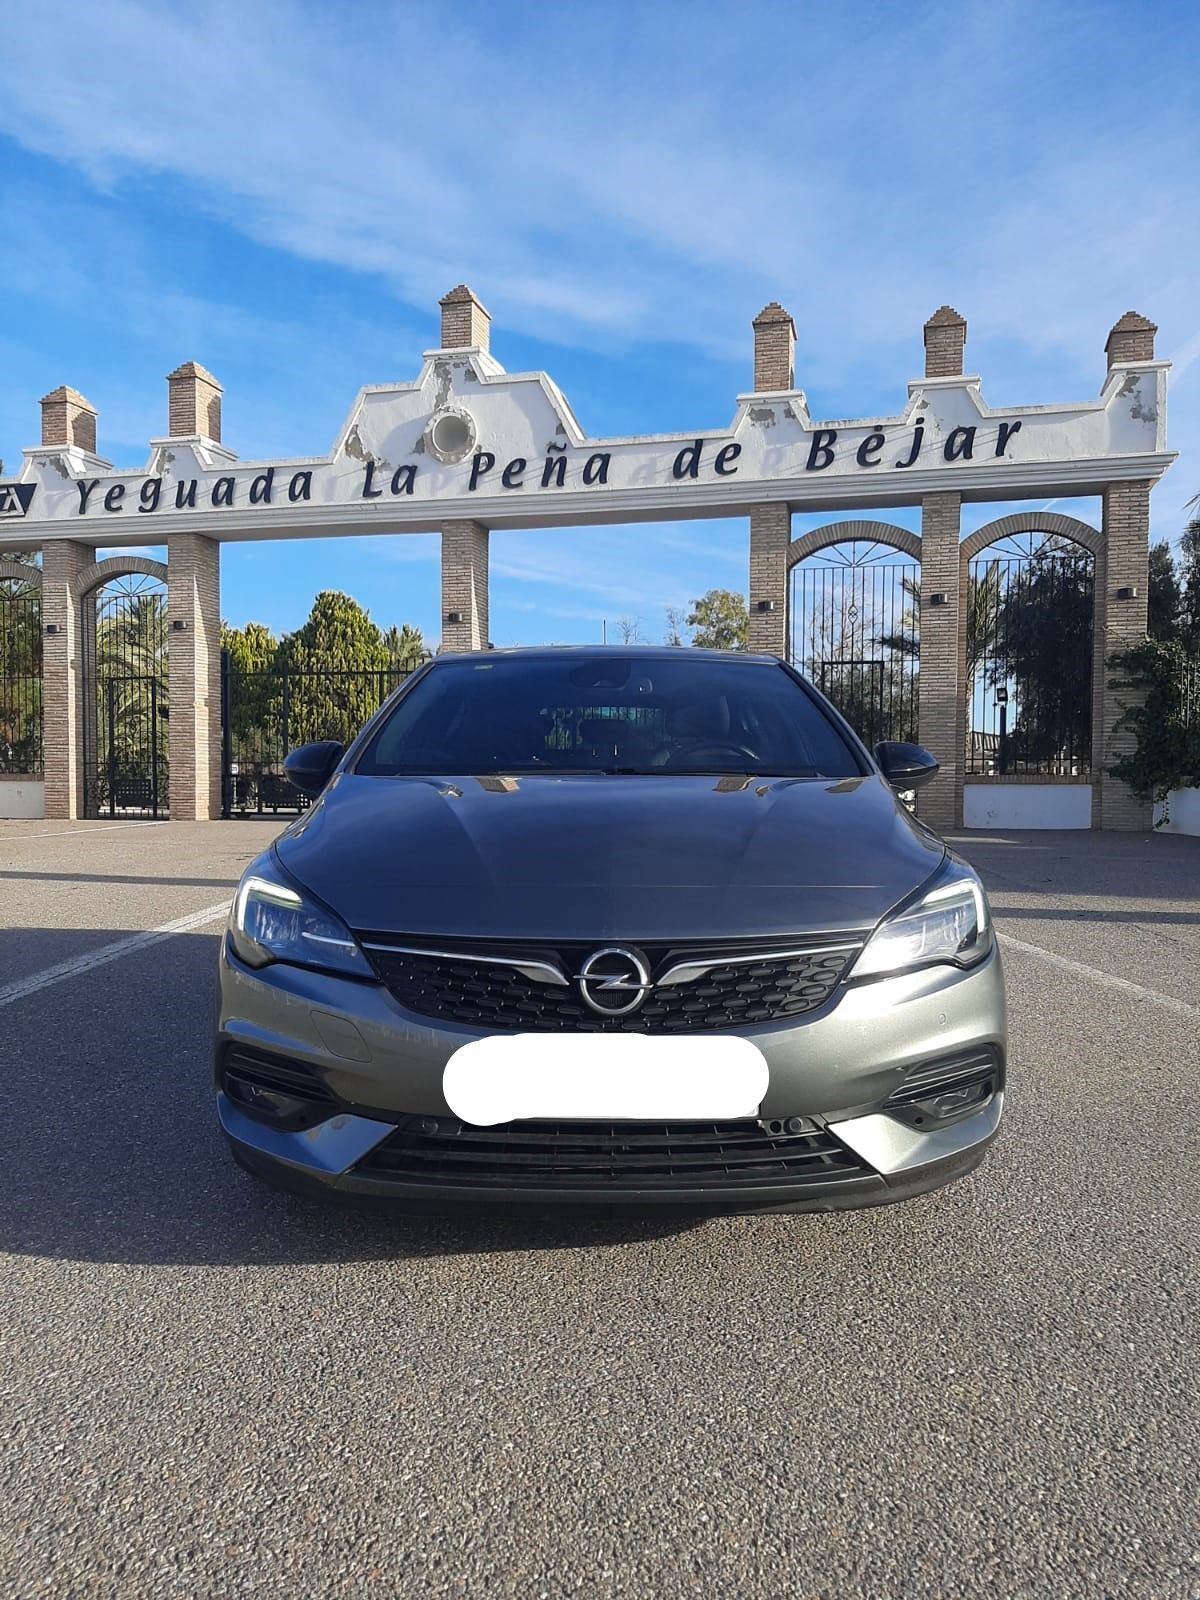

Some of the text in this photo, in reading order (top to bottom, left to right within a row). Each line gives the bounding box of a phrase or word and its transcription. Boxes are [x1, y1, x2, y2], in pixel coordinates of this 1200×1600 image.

[77, 467, 312, 515] Yeguada
[363, 461, 417, 498] La
[469, 442, 610, 491] Peña
[672, 439, 742, 480] de
